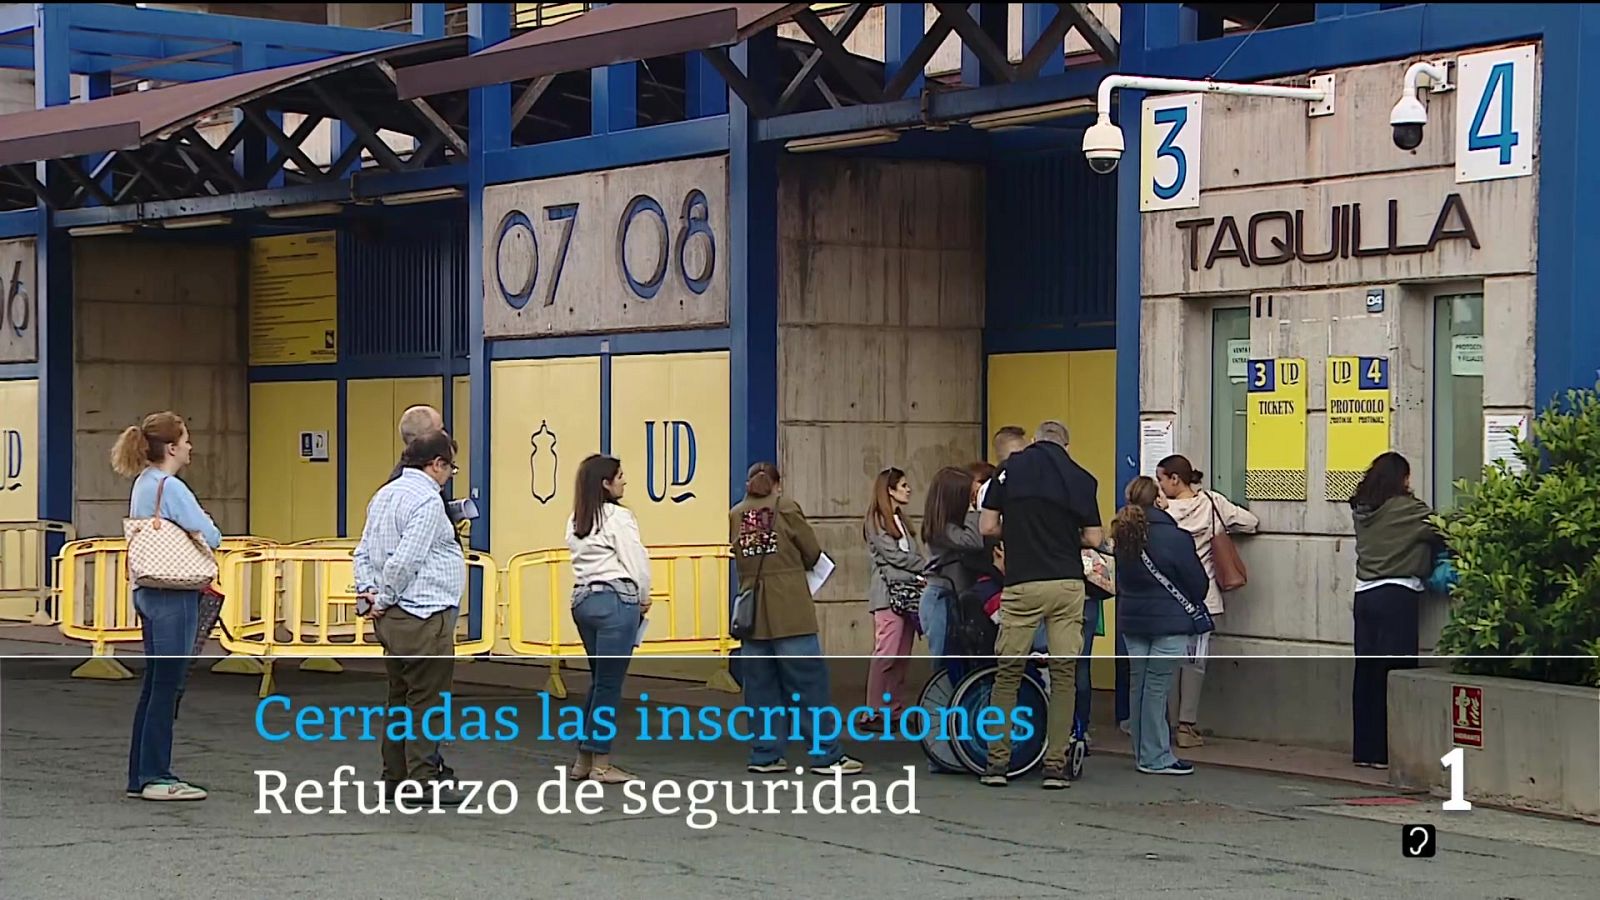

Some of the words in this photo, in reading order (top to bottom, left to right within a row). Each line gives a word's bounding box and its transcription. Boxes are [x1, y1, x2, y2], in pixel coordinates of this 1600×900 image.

[1152, 106, 1188, 200] 3
[1468, 61, 1520, 165] 4
[489, 202, 580, 310] 07
[616, 188, 716, 300] 08
[1175, 193, 1481, 271] TAQUILLA
[1254, 362, 1267, 387] 3
[1281, 362, 1299, 385] UD
[1258, 400, 1294, 415] TICKETS
[1330, 399, 1384, 414] PROTOCOLO
[1332, 360, 1351, 384] UD
[1366, 359, 1382, 384] 4
[644, 420, 697, 503] UD
